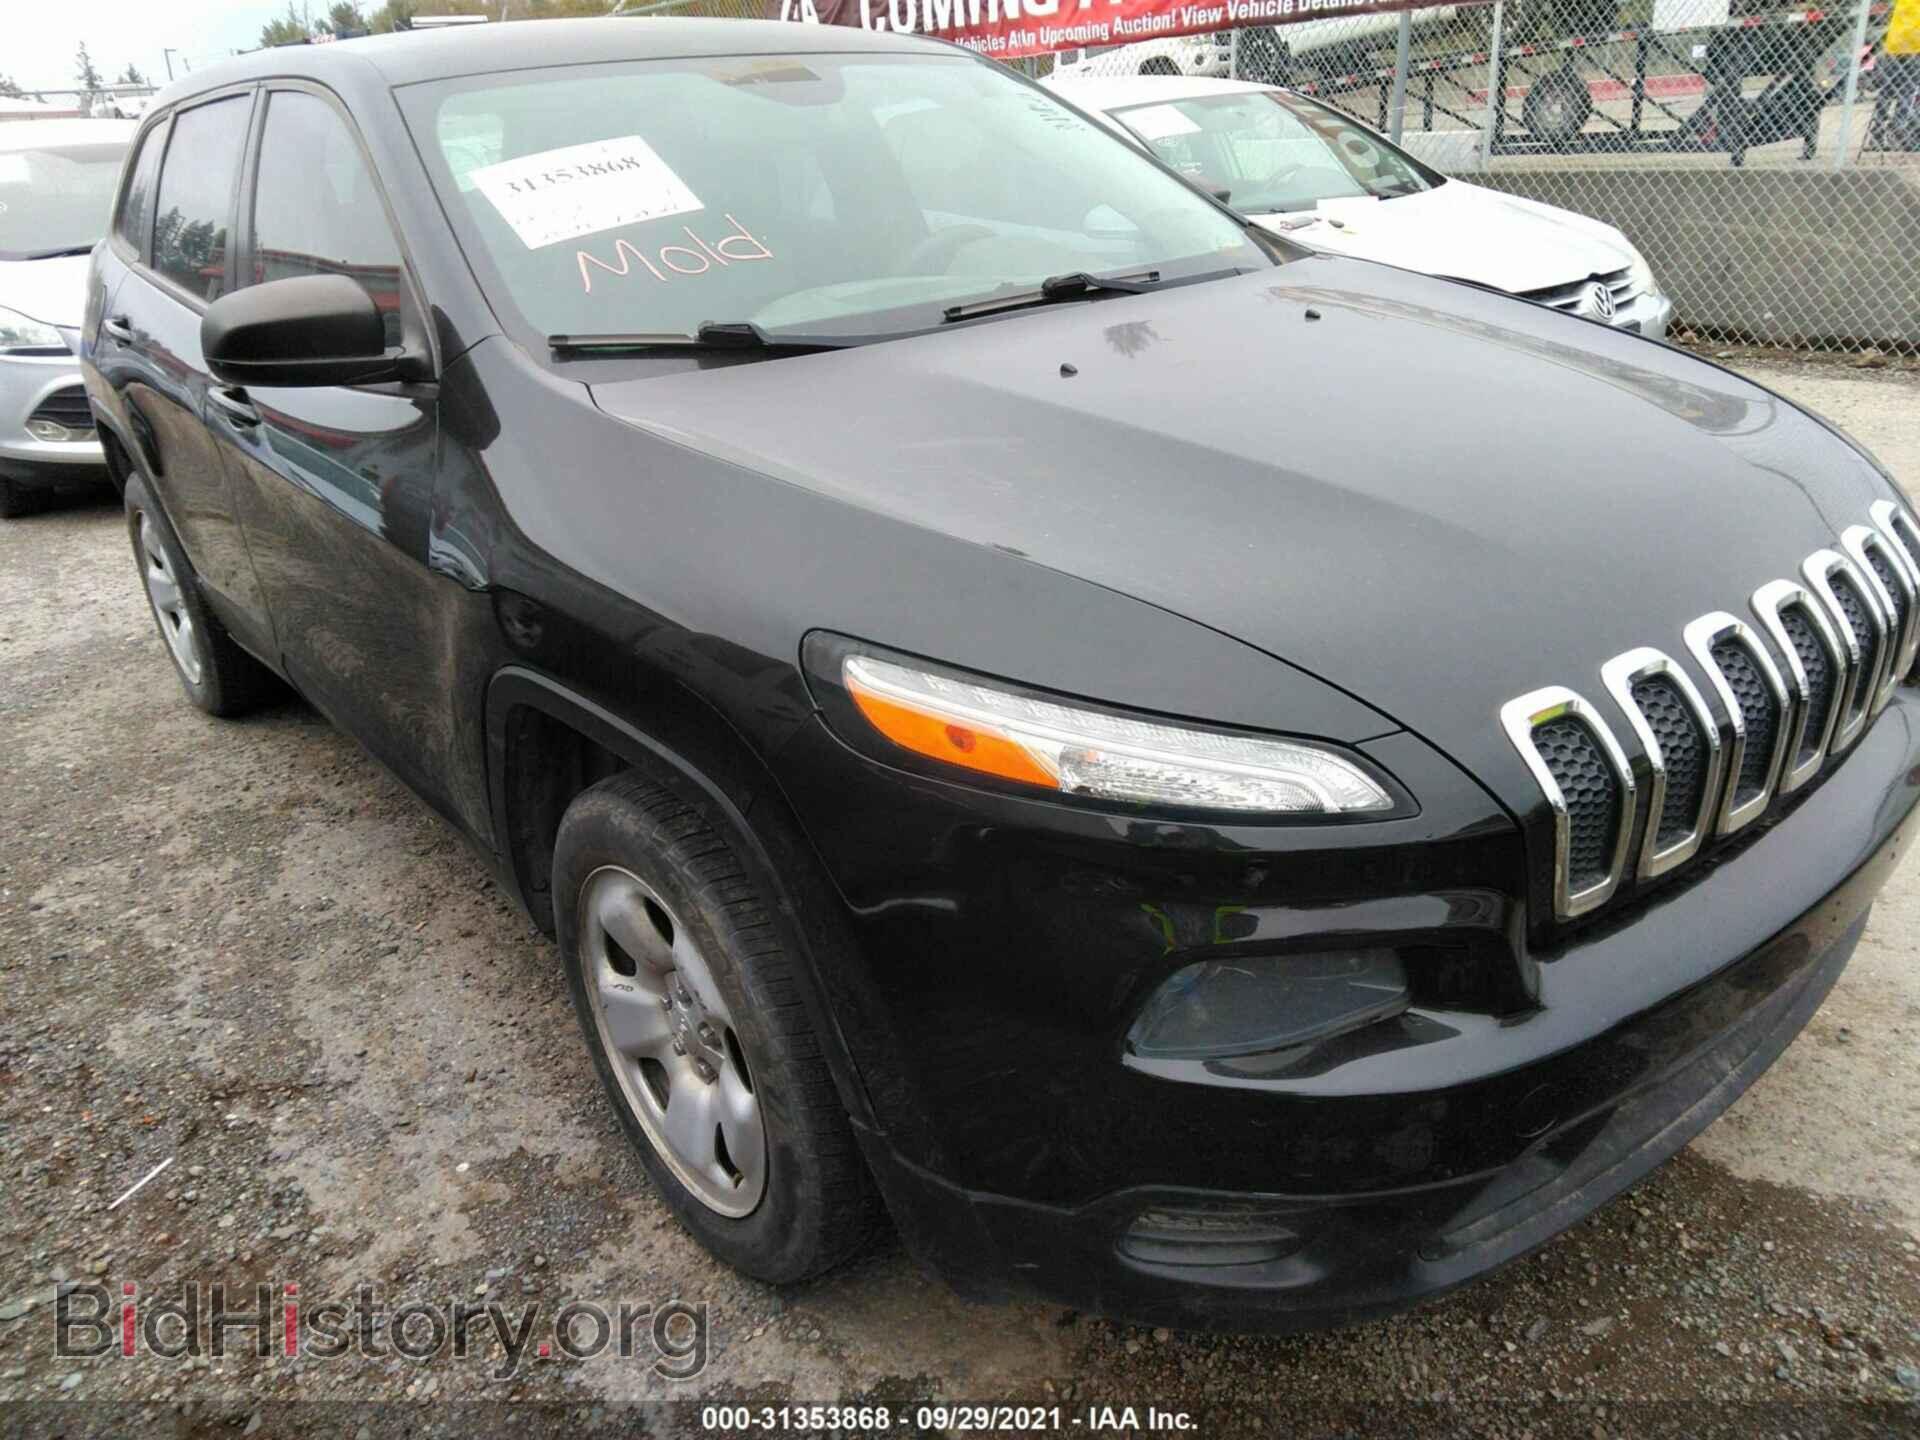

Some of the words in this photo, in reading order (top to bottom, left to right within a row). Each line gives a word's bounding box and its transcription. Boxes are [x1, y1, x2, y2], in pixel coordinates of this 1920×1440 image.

[1040, 20, 1109, 47] Upcoming
[1113, 9, 1176, 36] Auction!
[1181, 6, 1222, 27] View
[1227, 0, 1293, 20] Vehicle
[507, 156, 641, 194] 31353868
[576, 213, 774, 294] Mold
